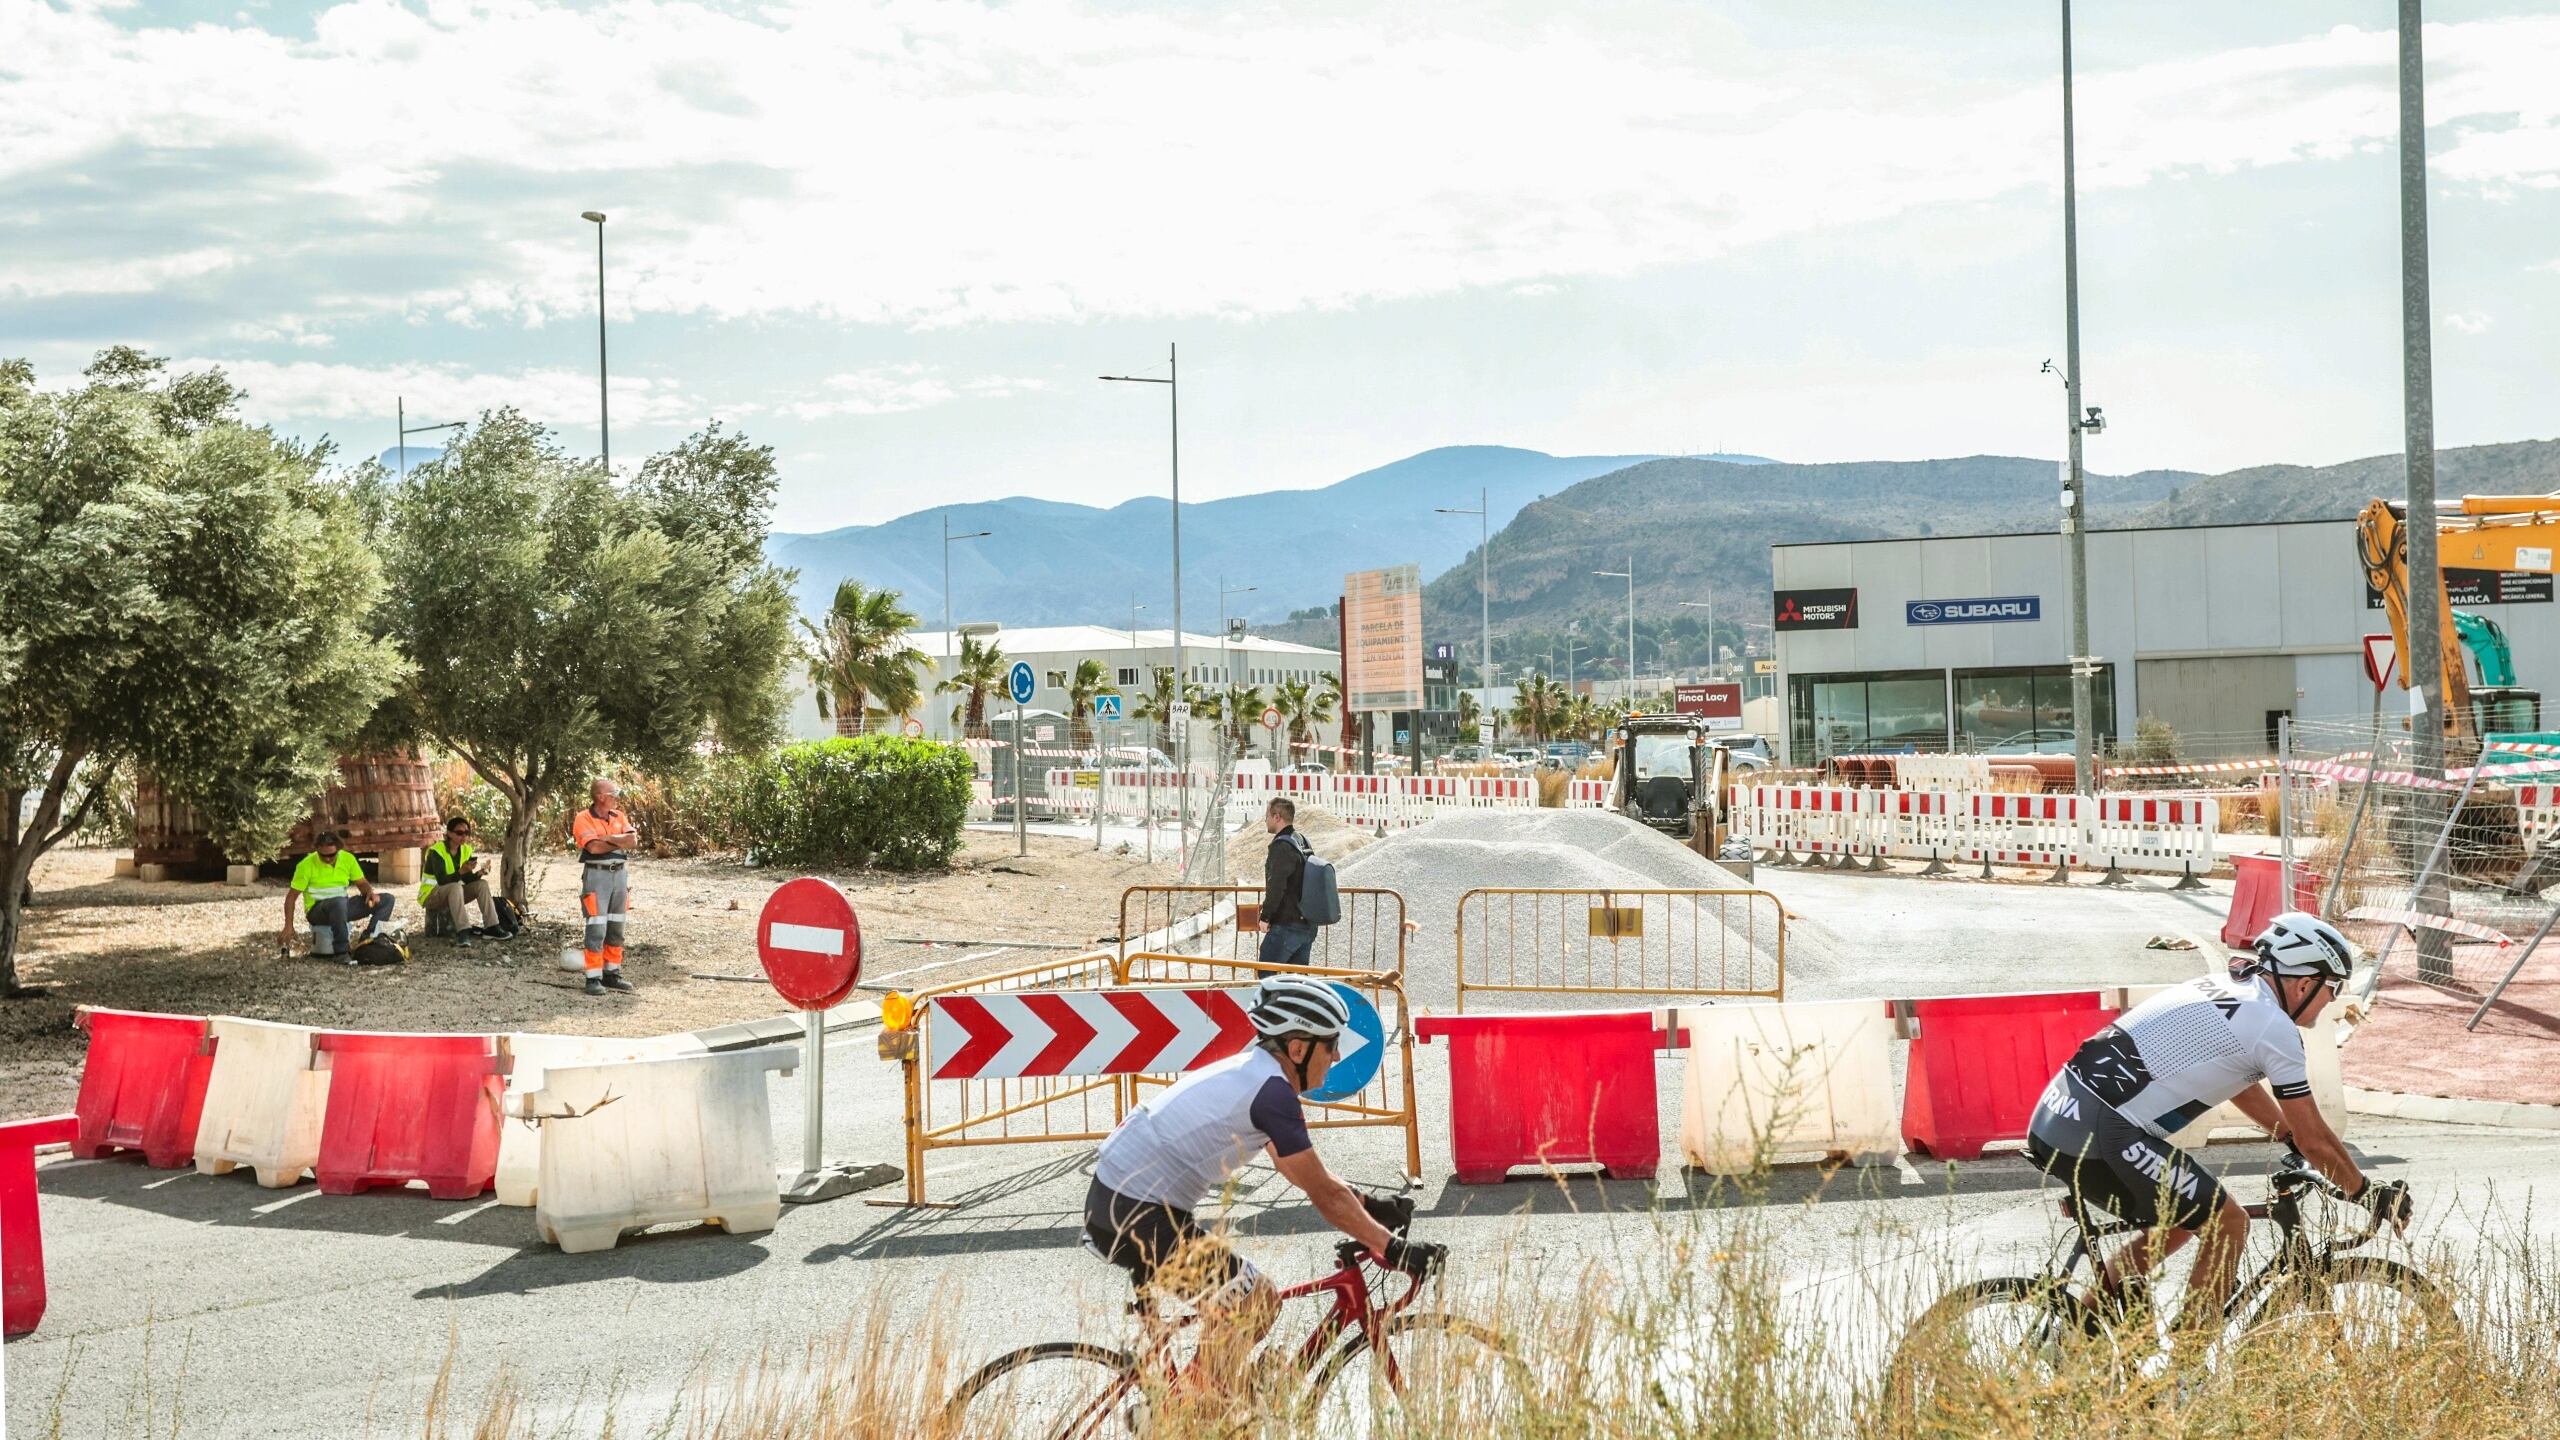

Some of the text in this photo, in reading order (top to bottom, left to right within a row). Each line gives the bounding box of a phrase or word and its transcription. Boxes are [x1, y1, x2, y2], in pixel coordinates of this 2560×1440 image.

[2450, 595, 2490, 605] MARCA
[1803, 605, 1846, 613] MITSUBISHI
[1944, 603, 2031, 617] SUBARU
[1803, 612, 1836, 620] MOTORS
[1361, 620, 1405, 634] PARCELA DE
[1678, 693, 1728, 702] Finca Lacy
[1173, 705, 1188, 713] BAR
